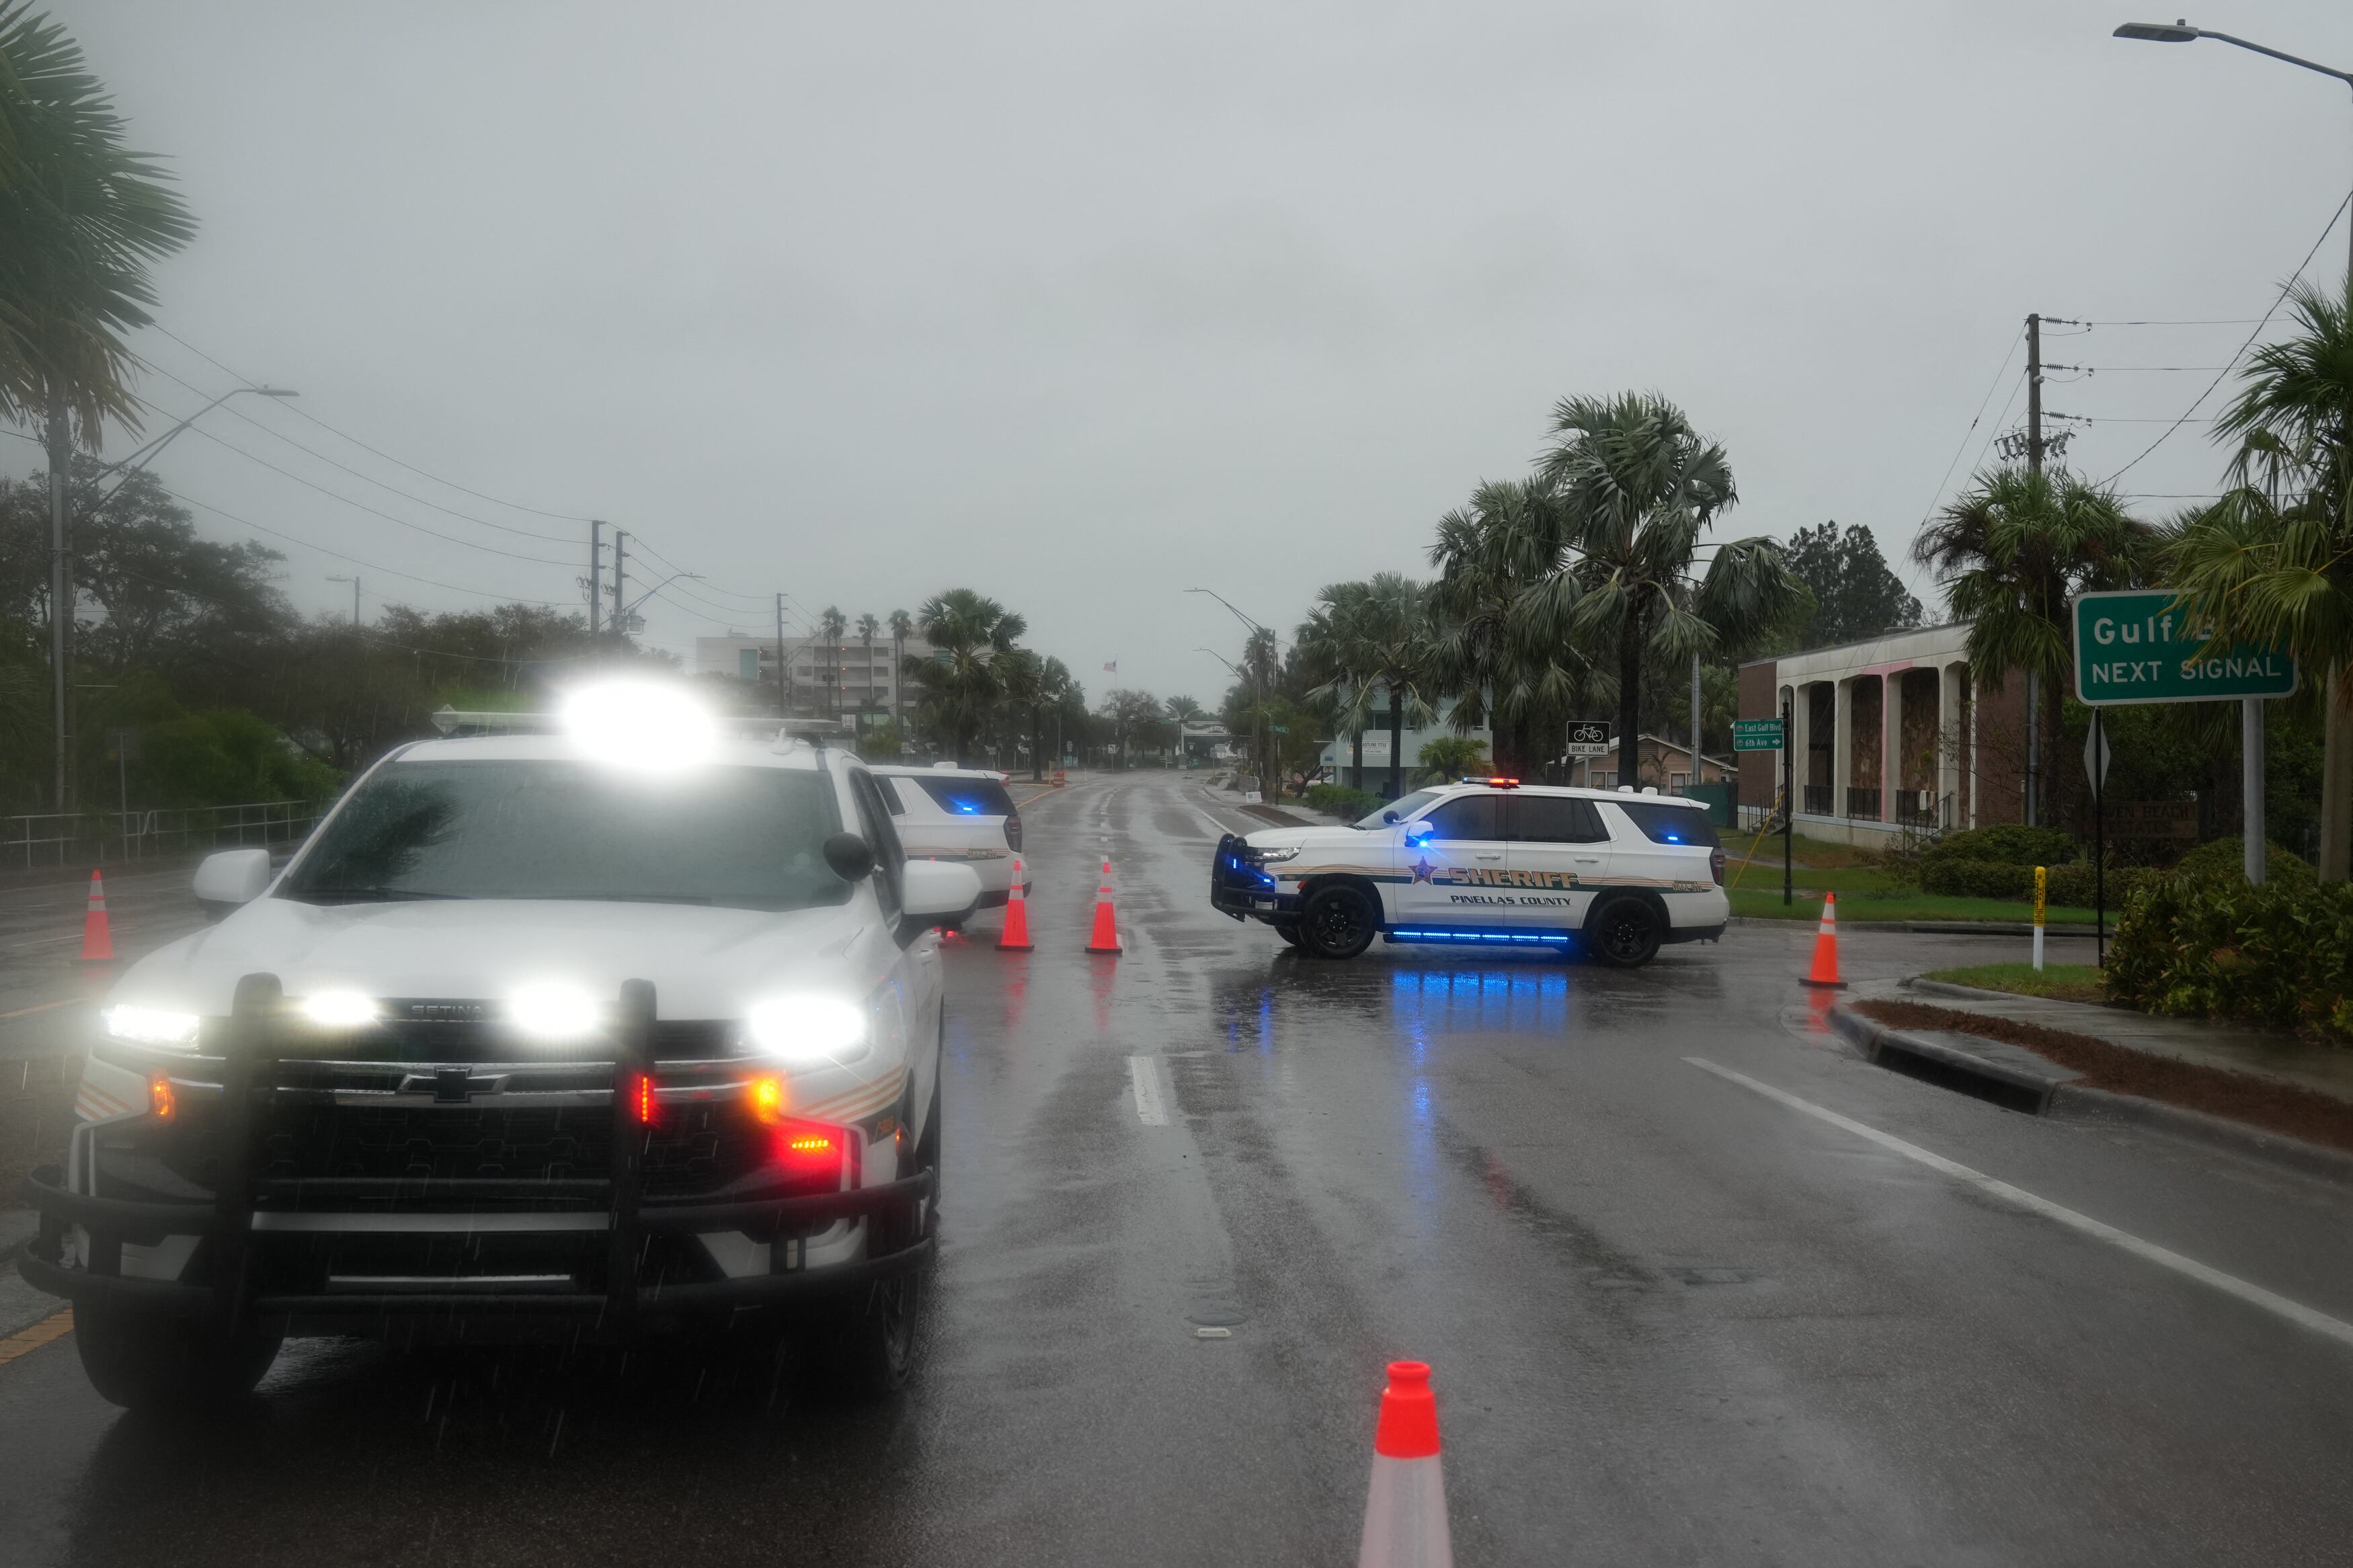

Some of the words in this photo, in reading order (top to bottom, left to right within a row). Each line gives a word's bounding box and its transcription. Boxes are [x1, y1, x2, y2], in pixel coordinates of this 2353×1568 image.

[2094, 614, 2172, 645] Gulf
[2092, 661, 2162, 684] NEXT
[2180, 656, 2282, 680] SIGNAL
[1745, 724, 1756, 732] East
[1757, 723, 1769, 731] Gulf
[1769, 723, 1782, 731] Blvd
[1745, 739, 1755, 747] 6th
[2143, 807, 2188, 818] BEACH
[1448, 867, 1579, 889] SHERIFF
[1450, 895, 1515, 904] PINELLAS
[1519, 896, 1570, 906] COUNTY
[411, 1005, 483, 1014] SETINA
